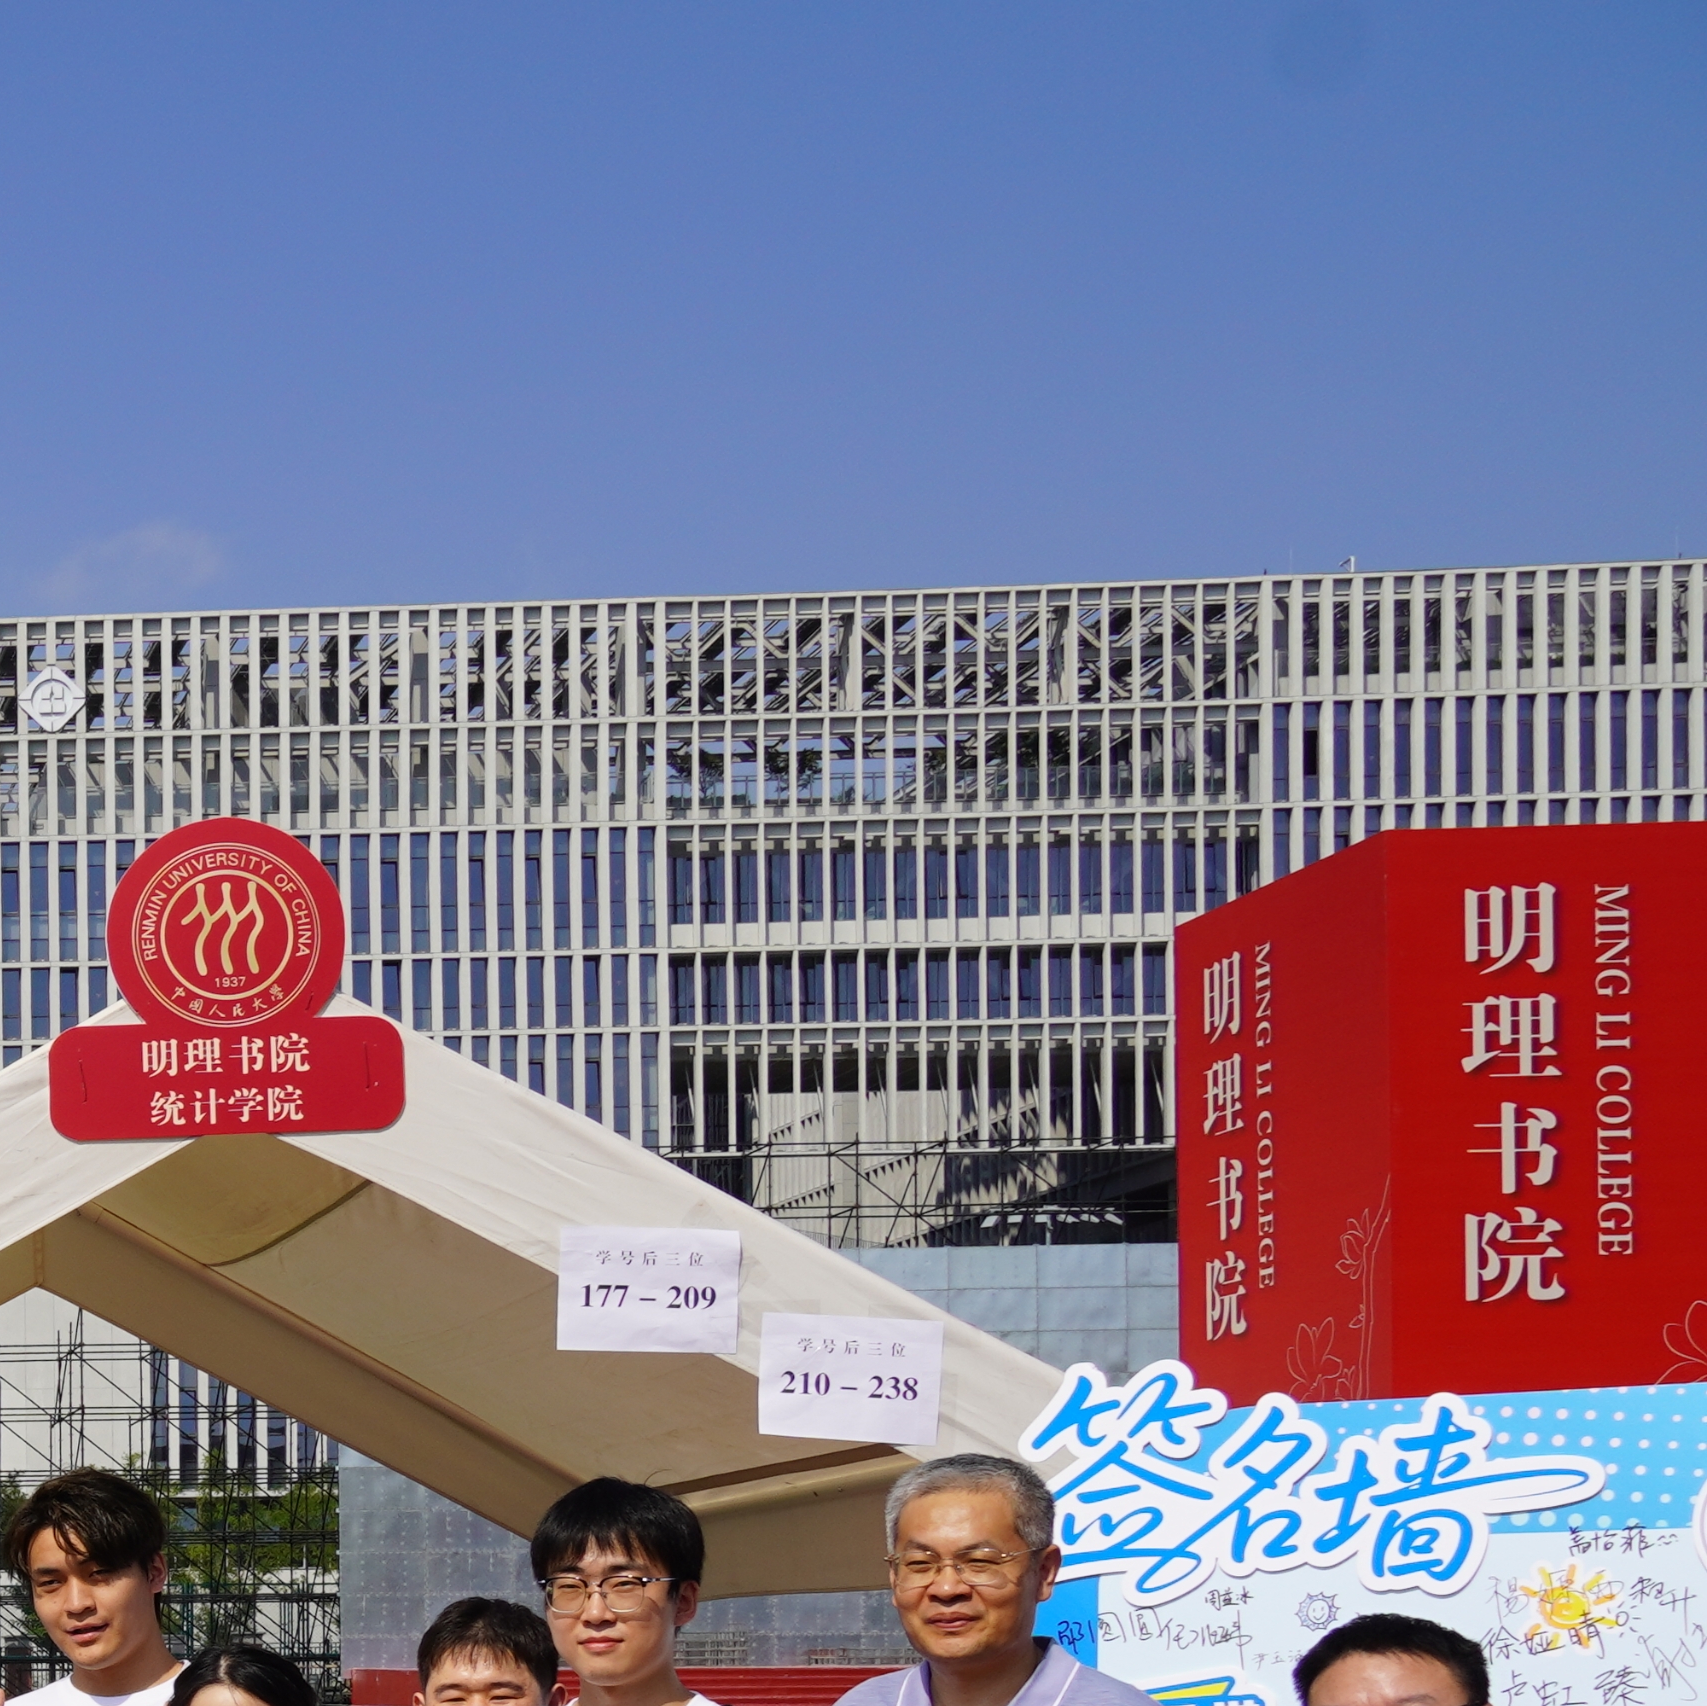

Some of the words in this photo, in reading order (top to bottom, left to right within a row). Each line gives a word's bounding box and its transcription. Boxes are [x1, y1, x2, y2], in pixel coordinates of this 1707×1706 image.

[141, 890, 167, 962] RENMIN
[163, 852, 273, 889] UNIVERSITY
[274, 873, 298, 896] OF
[292, 898, 312, 958] CHINA
[1593, 883, 1632, 998] MING
[214, 976, 246, 988] 1937
[1254, 940, 1272, 1049] MING
[1594, 1011, 1632, 1050] LI
[141, 1032, 311, 1078] 明理书院
[1255, 1060, 1273, 1098] LI
[1460, 881, 1566, 1302] 明理书院
[150, 1085, 305, 1127] 统计学院
[1202, 950, 1248, 1342] 明理书院
[1595, 1065, 1634, 1256] COLLEGE
[1256, 1110, 1275, 1290] COLLEGE
[595, 1249, 704, 1268] 学号后三位
[581, 1284, 630, 1309] 177
[665, 1285, 717, 1310] 209
[797, 1337, 907, 1359] 学号后三位
[780, 1370, 830, 1396] 210
[867, 1375, 919, 1401] 238
[1033, 1372, 1588, 1592] 签名墙
